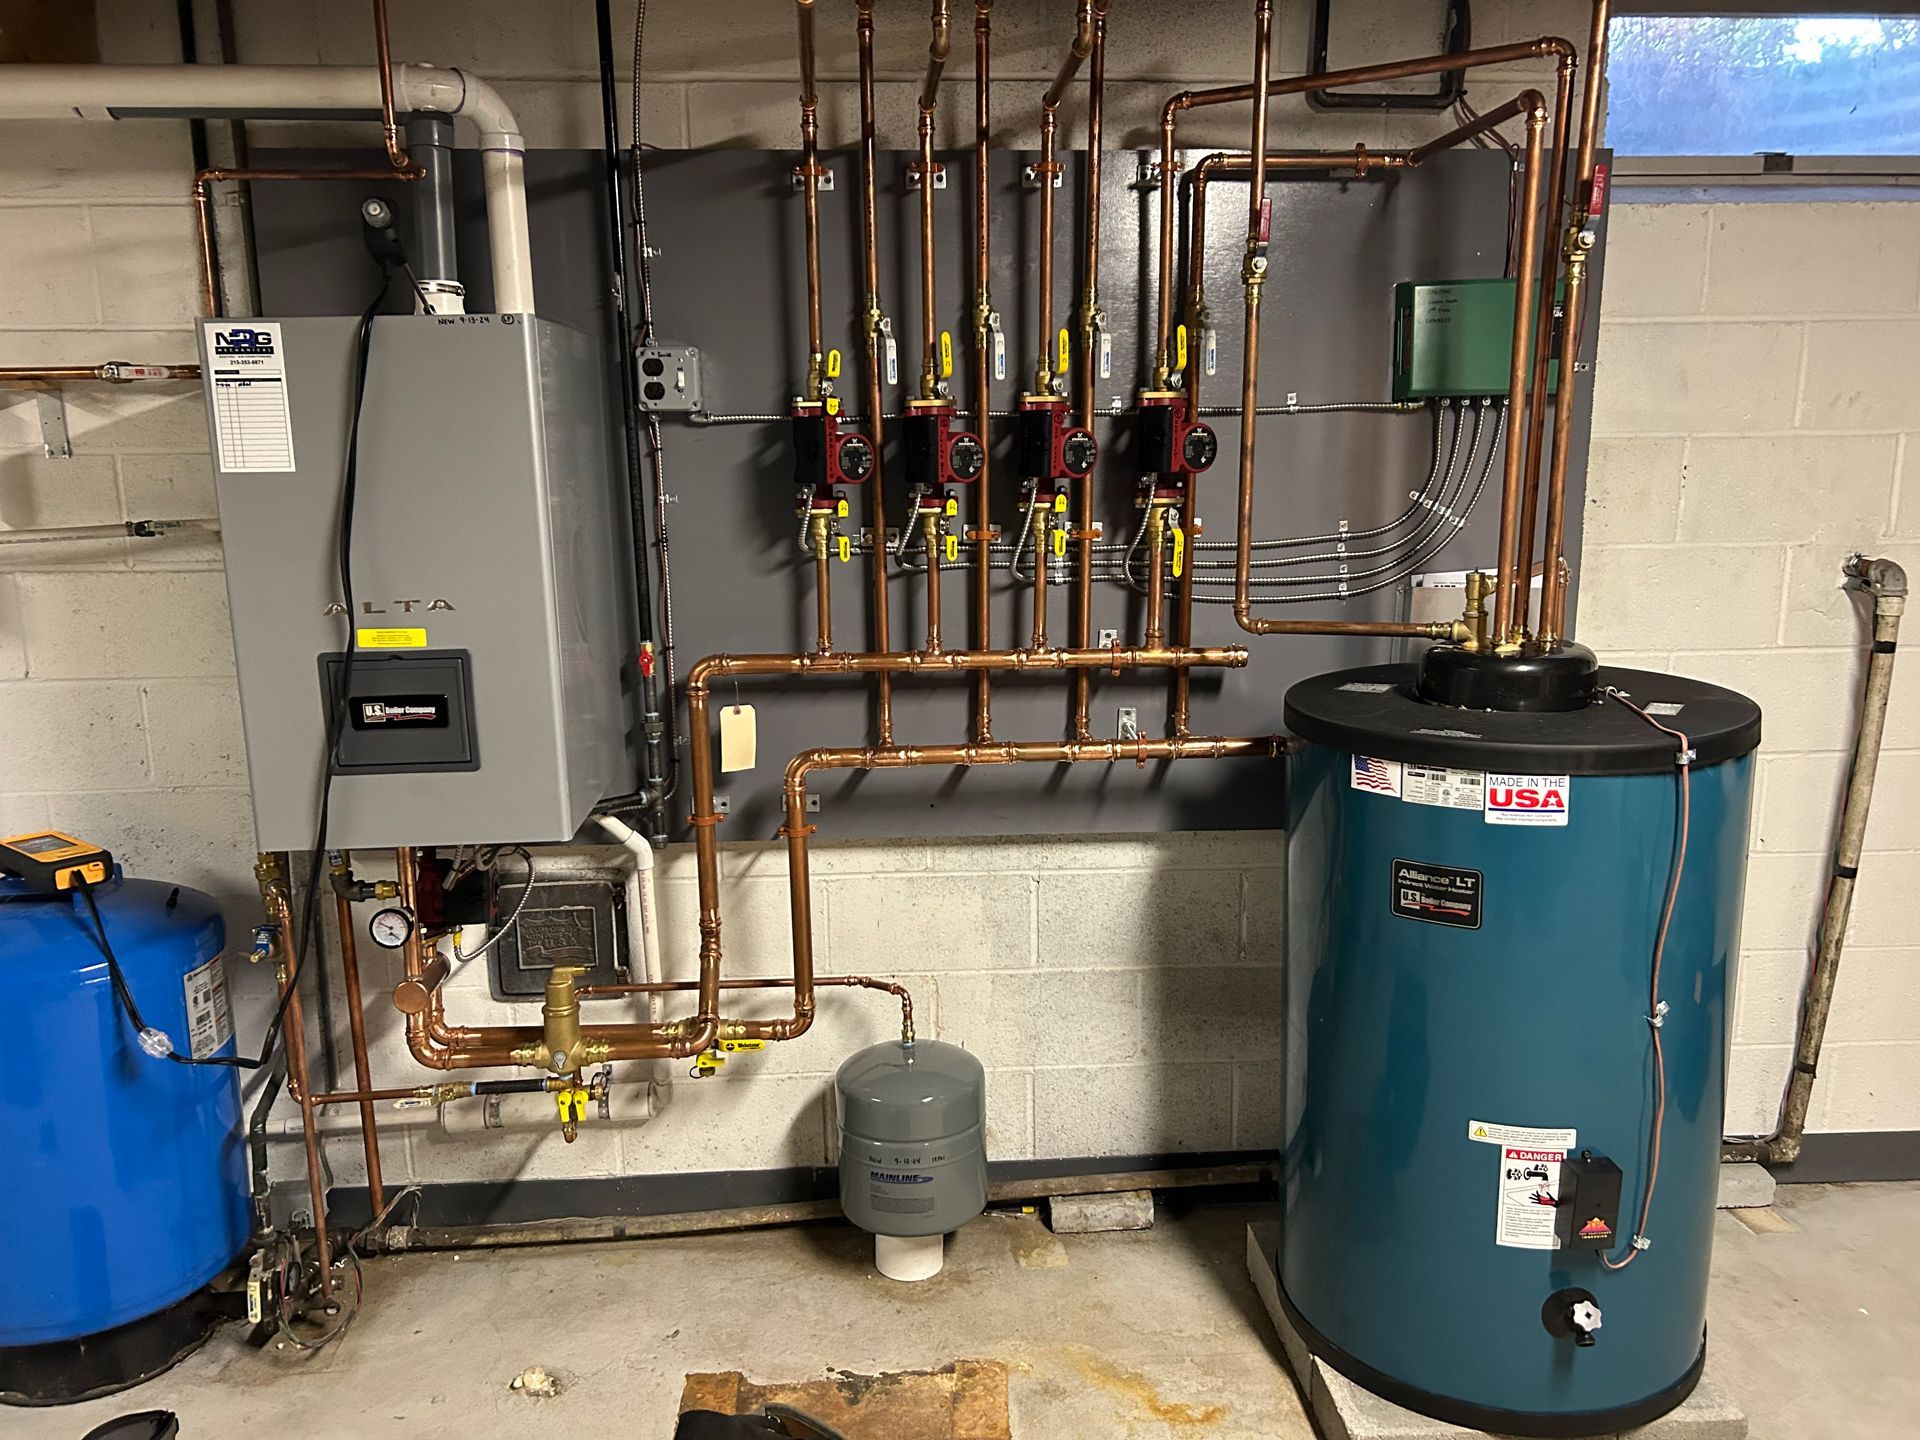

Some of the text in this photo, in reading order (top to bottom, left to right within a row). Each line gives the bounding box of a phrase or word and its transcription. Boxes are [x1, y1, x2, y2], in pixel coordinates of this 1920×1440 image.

[459, 316, 490, 324] 9-13-24
[323, 599, 456, 616] ALTA
[365, 705, 384, 716] U.S.
[1489, 776, 1566, 788] MADE IN THE
[1489, 787, 1565, 808] USA
[1398, 878, 1476, 895] Indirect Water Heater
[1456, 877, 1476, 888] LT
[1402, 891, 1419, 903] U.S.
[1519, 1151, 1562, 1162] DANGER
[870, 1171, 920, 1183] MAINLINE
